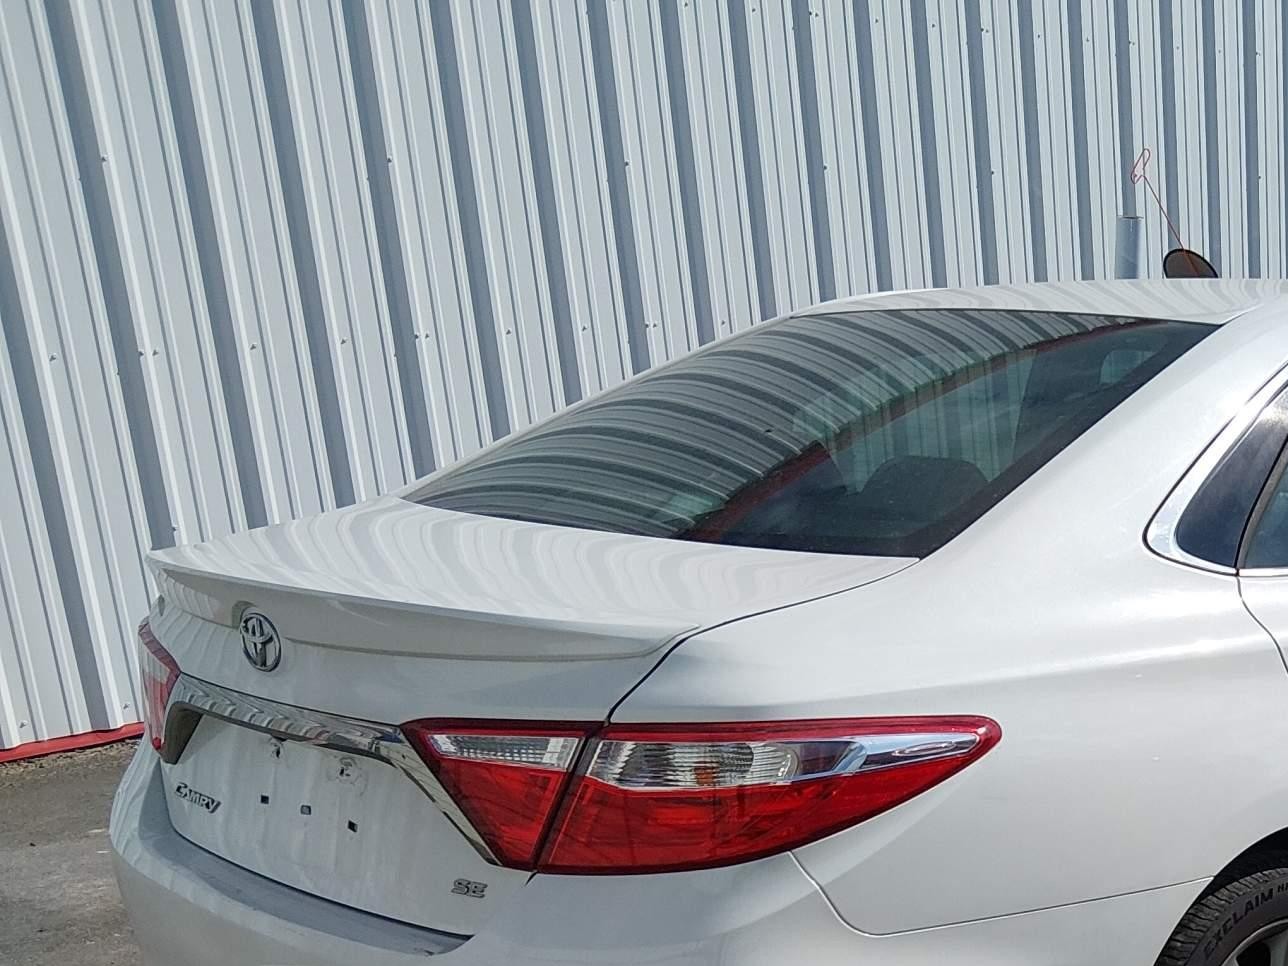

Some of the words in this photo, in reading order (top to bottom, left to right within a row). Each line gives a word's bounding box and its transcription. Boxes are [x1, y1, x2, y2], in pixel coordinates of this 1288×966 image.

[175, 781, 222, 814] CAMRY
[450, 878, 489, 899] SE
[1204, 887, 1275, 961] EXCLAIM
